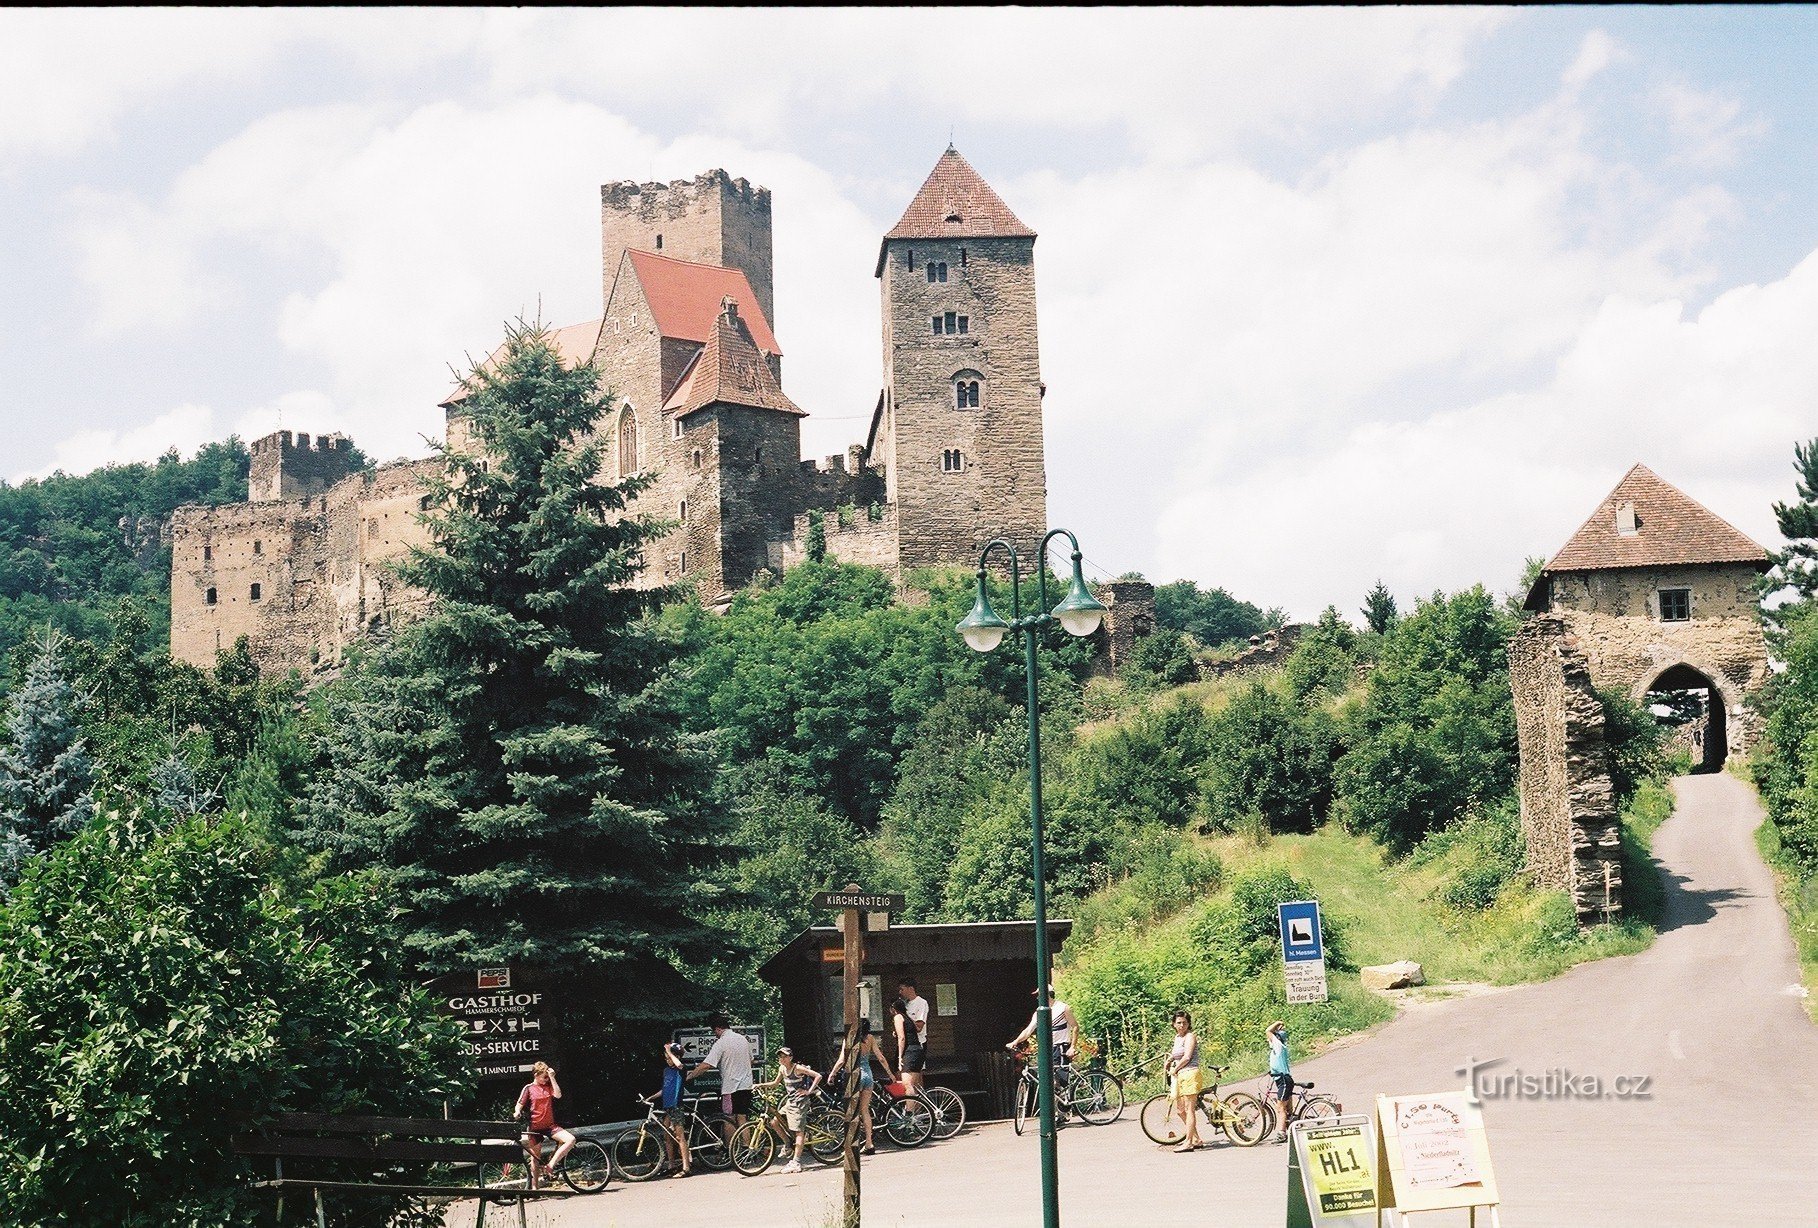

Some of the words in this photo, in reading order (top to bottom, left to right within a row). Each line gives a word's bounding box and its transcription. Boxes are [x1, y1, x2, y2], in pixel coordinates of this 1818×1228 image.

[826, 895, 891, 907] KIRCHENSTEIG
[1291, 985, 1320, 993] Trauung
[448, 993, 542, 1010] GASTHOF
[465, 1005, 526, 1015] HAMMERSCHMIEDE
[489, 1065, 517, 1075] MINUTE
[1309, 1142, 1336, 1153] www.
[1319, 1147, 1361, 1177] HL1
